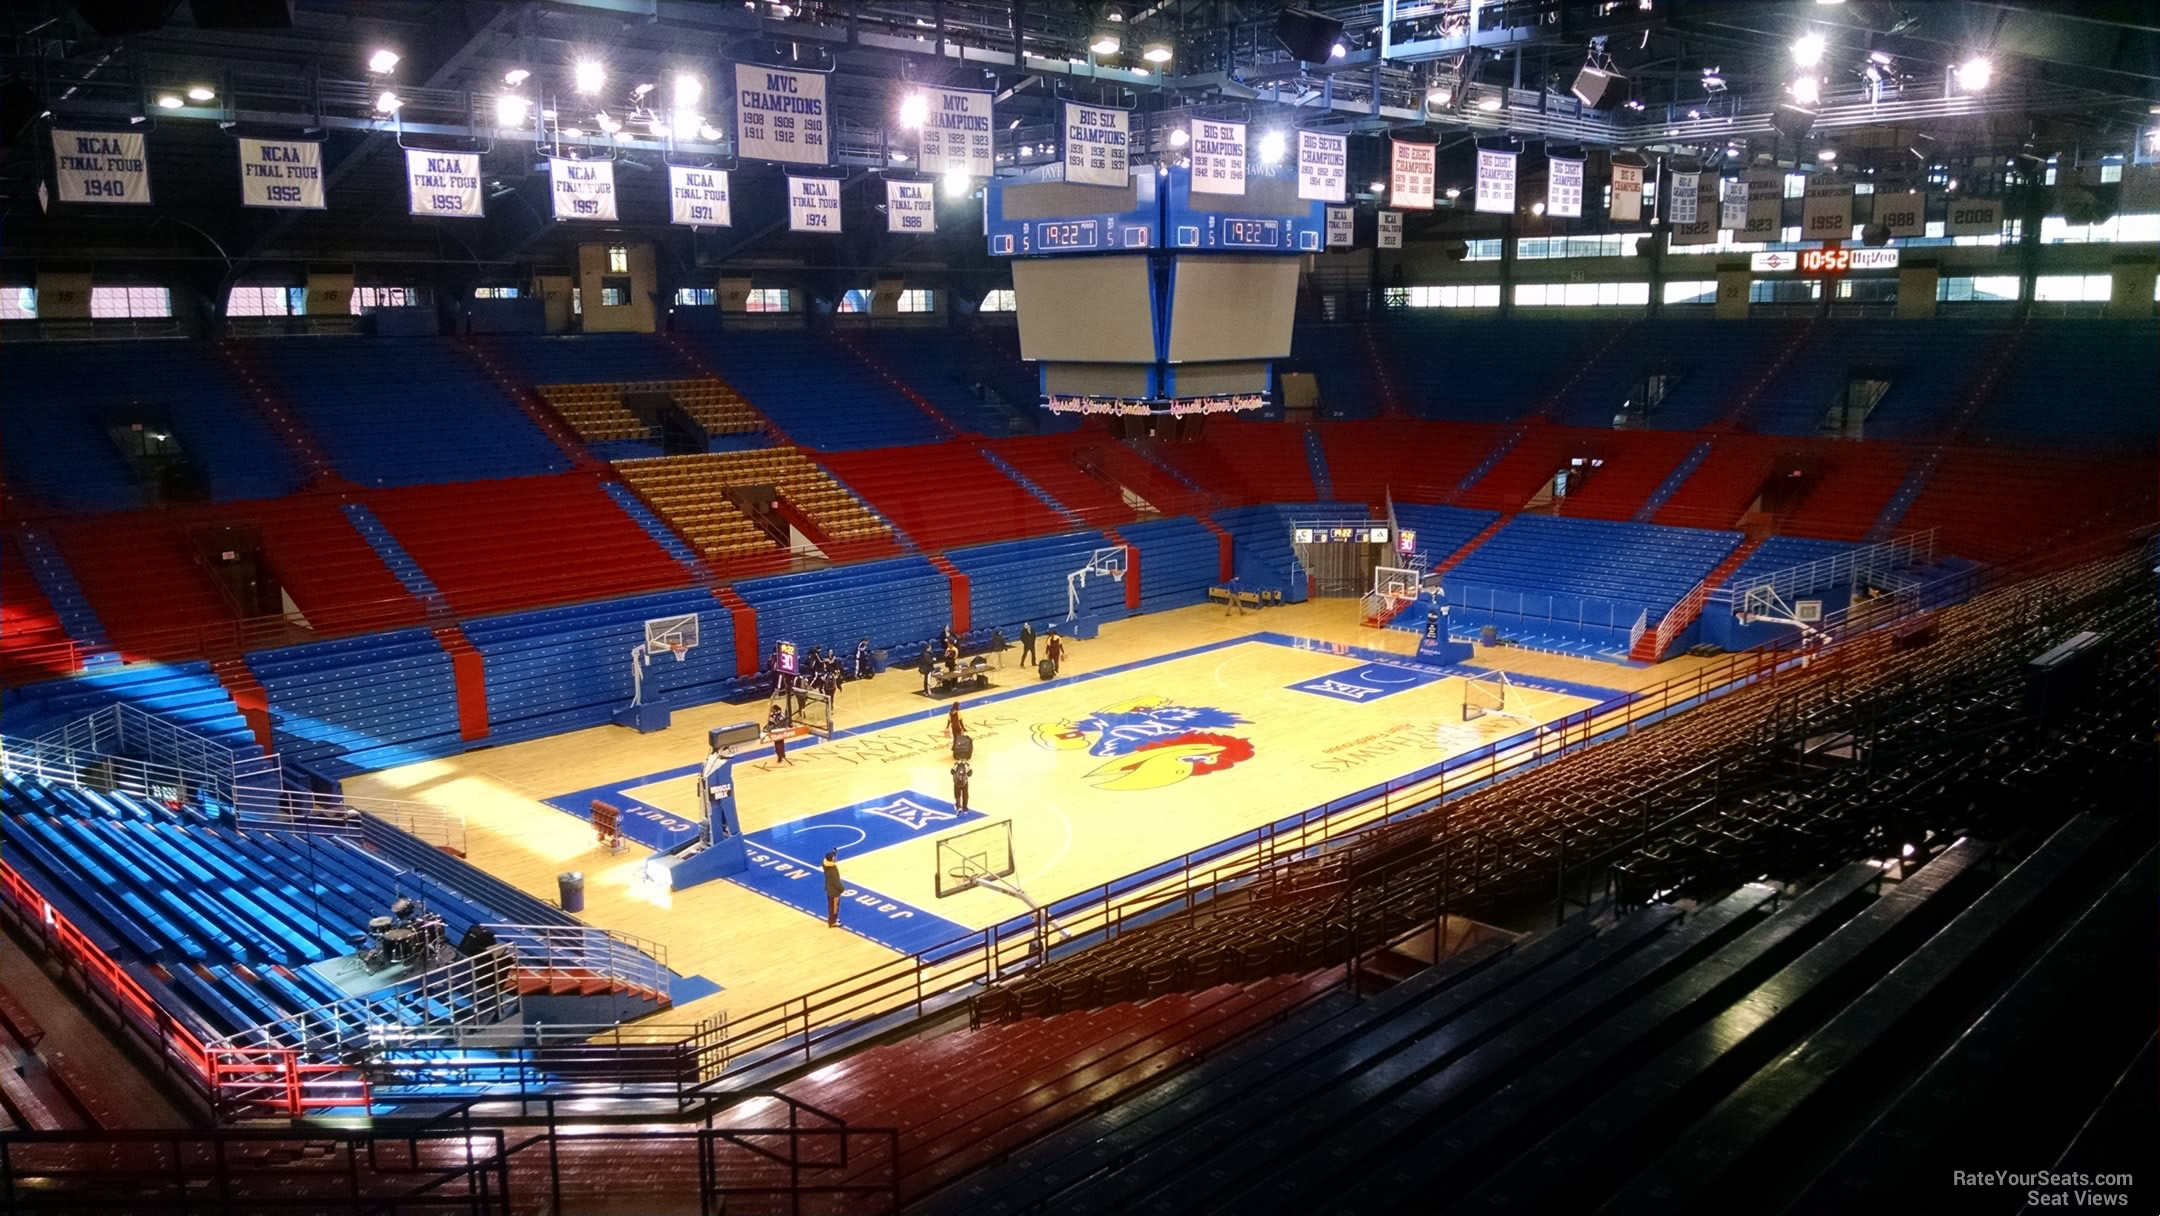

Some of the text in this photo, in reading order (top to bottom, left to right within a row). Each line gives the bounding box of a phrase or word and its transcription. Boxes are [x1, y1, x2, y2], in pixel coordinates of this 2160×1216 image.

[766, 73, 797, 94] MVC
[741, 89, 822, 116] CHAMPIONS
[943, 94, 969, 112] MVC
[743, 112, 823, 132] 1908 1909 1910
[924, 111, 989, 132] HAMPIONS
[1080, 109, 1116, 128] BIG SIX
[744, 126, 823, 146] 1911 1912 1914
[923, 130, 989, 146] 1915 1922 1923
[1069, 125, 1126, 146] CHAMPIONS
[1203, 124, 1235, 140] BIG SIX
[76, 137, 122, 155] NCAA
[923, 143, 989, 159] 1924 1925 1926
[1070, 143, 1125, 159] 1931 1932 1933
[1195, 139, 1243, 157] CHAMPIONS
[1303, 135, 1342, 152] BIG SEVEN
[261, 146, 301, 163] NCAA
[1301, 149, 1344, 166] CHAMPIONS
[1399, 146, 1410, 159] BIG
[60, 156, 143, 172] FINAL FOUR
[427, 158, 462, 174] NCAA
[1069, 155, 1125, 170] 1934 1936 1937
[1213, 158, 1226, 168] 1940
[1395, 159, 1433, 174] CHAMPIONS
[246, 163, 318, 179] FINAL FOUR
[567, 166, 597, 180] NCAA
[1041, 166, 1064, 182] JAYH
[1195, 167, 1208, 177] 1942
[1480, 167, 1514, 180] CHAMPIONS
[84, 179, 124, 197] 1940
[414, 174, 477, 189] FINAL FOUR
[686, 173, 714, 188] NCAA
[1552, 174, 1581, 187] CHAMPIONS
[266, 185, 302, 202] 1952
[675, 187, 727, 201] FINAL FOUR
[802, 182, 827, 196] NCAA
[899, 186, 922, 199] NCAA
[1807, 188, 1852, 197] CHAMPIONS
[432, 194, 463, 210] 1953
[573, 199, 599, 214] 1957
[793, 196, 838, 209] FINAL FOUR
[891, 199, 932, 211] FINAL FOUR
[691, 205, 713, 220] 1971
[805, 213, 827, 226] 1974
[1882, 212, 1915, 228] 1988
[1953, 209, 1994, 224] 2008
[902, 215, 922, 228] 1986
[1811, 215, 1843, 230] 1952
[1046, 225, 1079, 245] 19:22
[1138, 228, 1146, 244] 0
[1232, 223, 1262, 242] 19:22
[1005, 236, 1012, 250] 0
[1803, 250, 1849, 270] 10:52
[59, 291, 73, 300] 15
[324, 291, 337, 300] 16
[547, 291, 557, 299] 17
[1727, 287, 1739, 298] 22
[1049, 394, 1151, 416] Russell Stover Candies
[1170, 394, 1263, 419] Russell Stover Candies
[1401, 539, 1413, 550] 30
[781, 654, 794, 671] 30
[1374, 657, 1568, 694] Naismith Court
[752, 733, 903, 773] KANSAS
[710, 783, 731, 794] MUSCLE
[714, 790, 728, 800] MILK
[625, 806, 915, 921] Jame Court
